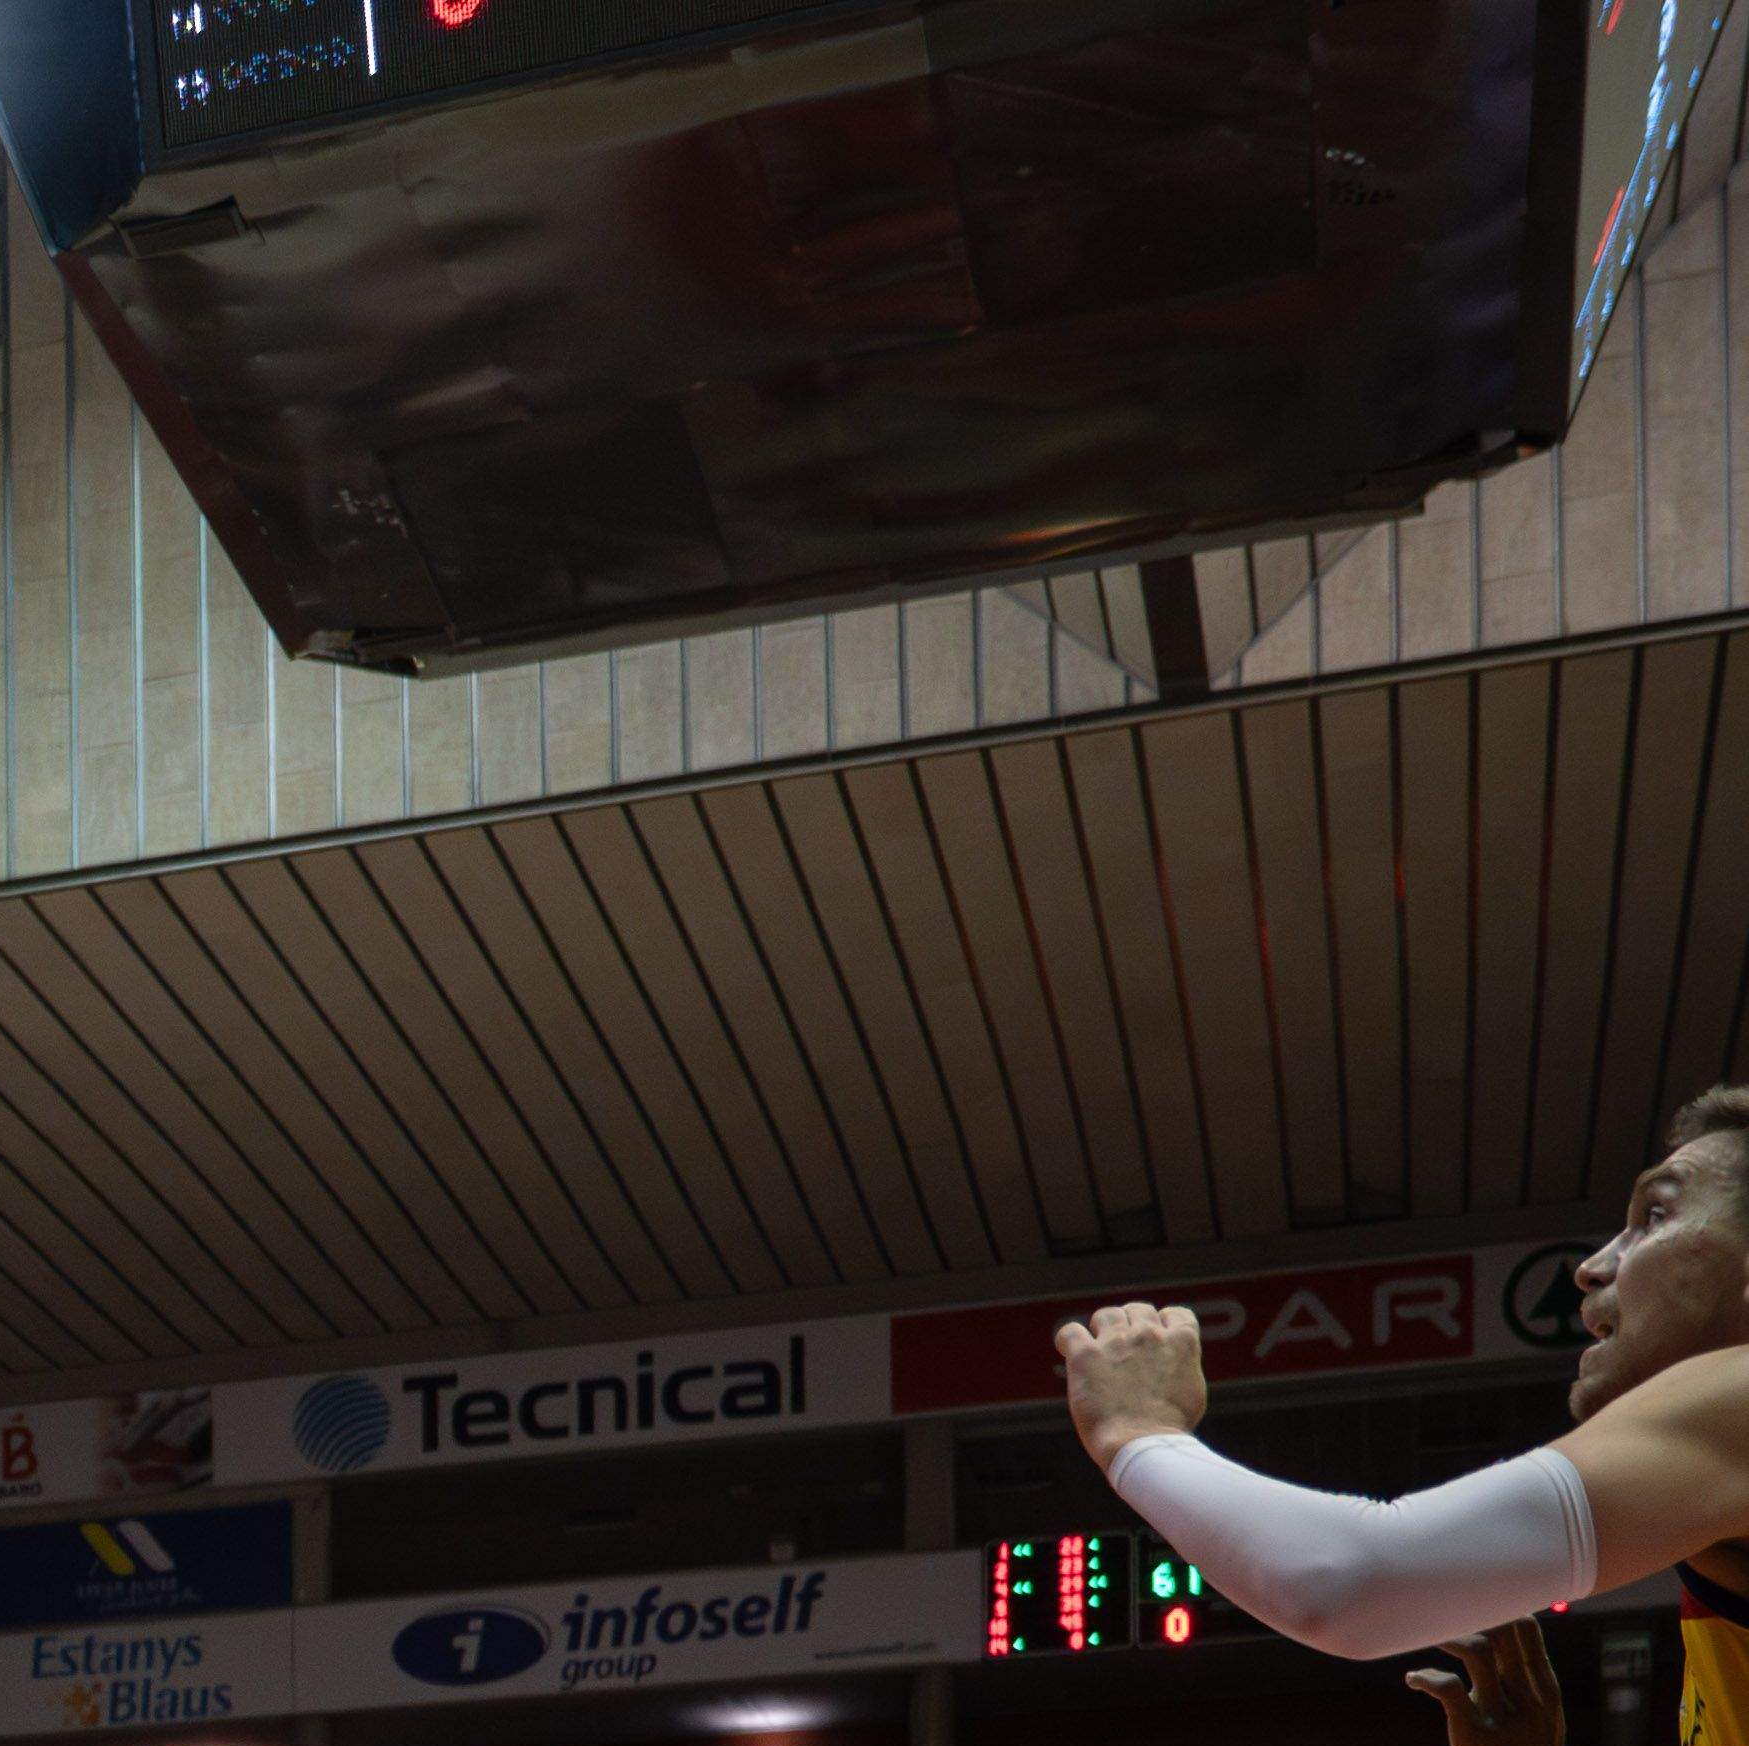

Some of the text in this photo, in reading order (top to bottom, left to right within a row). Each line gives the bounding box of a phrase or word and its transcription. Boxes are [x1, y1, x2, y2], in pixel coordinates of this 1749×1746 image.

[402, 1334, 806, 1454] Tecnical
[561, 1570, 827, 1652] infoself
[31, 1634, 203, 1682] Estanys
[561, 1653, 658, 1692] group
[108, 1677, 234, 1725] Blaus
